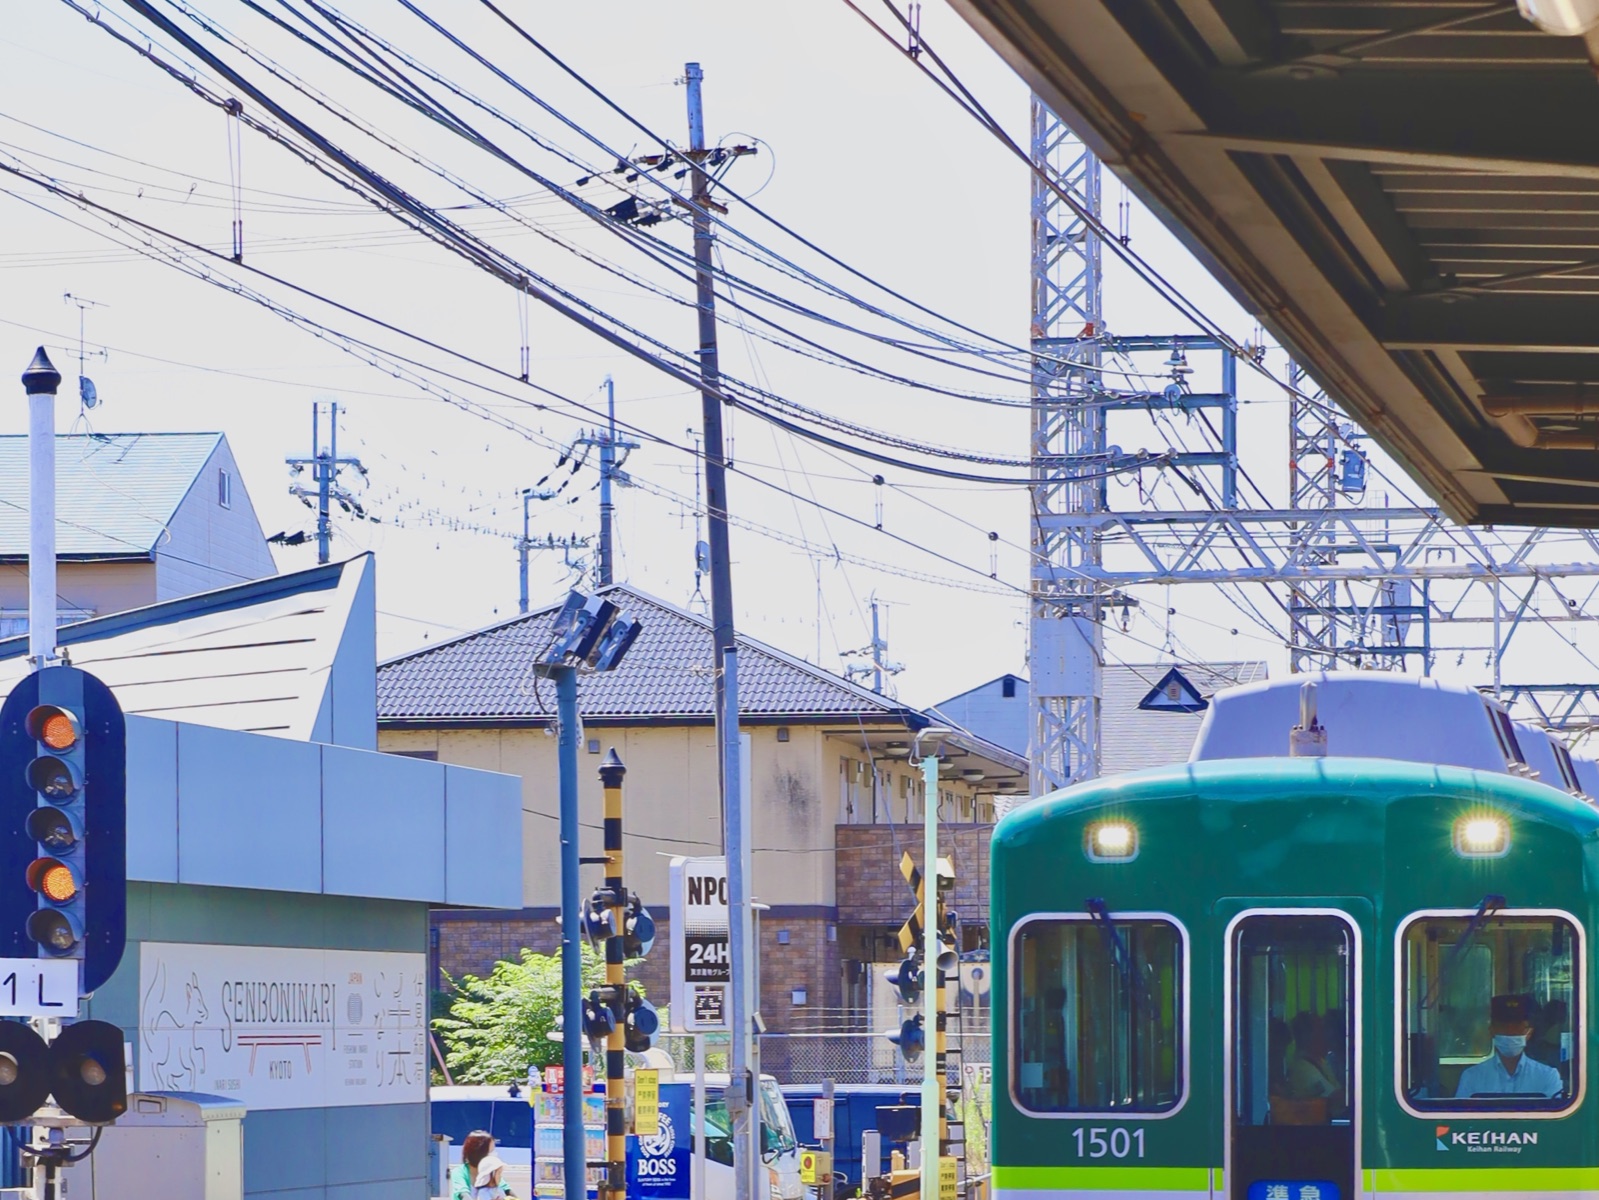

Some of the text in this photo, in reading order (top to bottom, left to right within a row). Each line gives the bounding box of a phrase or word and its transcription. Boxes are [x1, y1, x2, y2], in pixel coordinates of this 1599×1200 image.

[689, 943, 729, 964] 24H
[221, 981, 336, 1052] SENBONINARI
[269, 1060, 292, 1079] KYOTO
[1072, 1127, 1144, 1158] 1501
[1452, 1131, 1538, 1145] KEIHAN
[637, 1158, 677, 1176] BOSS
